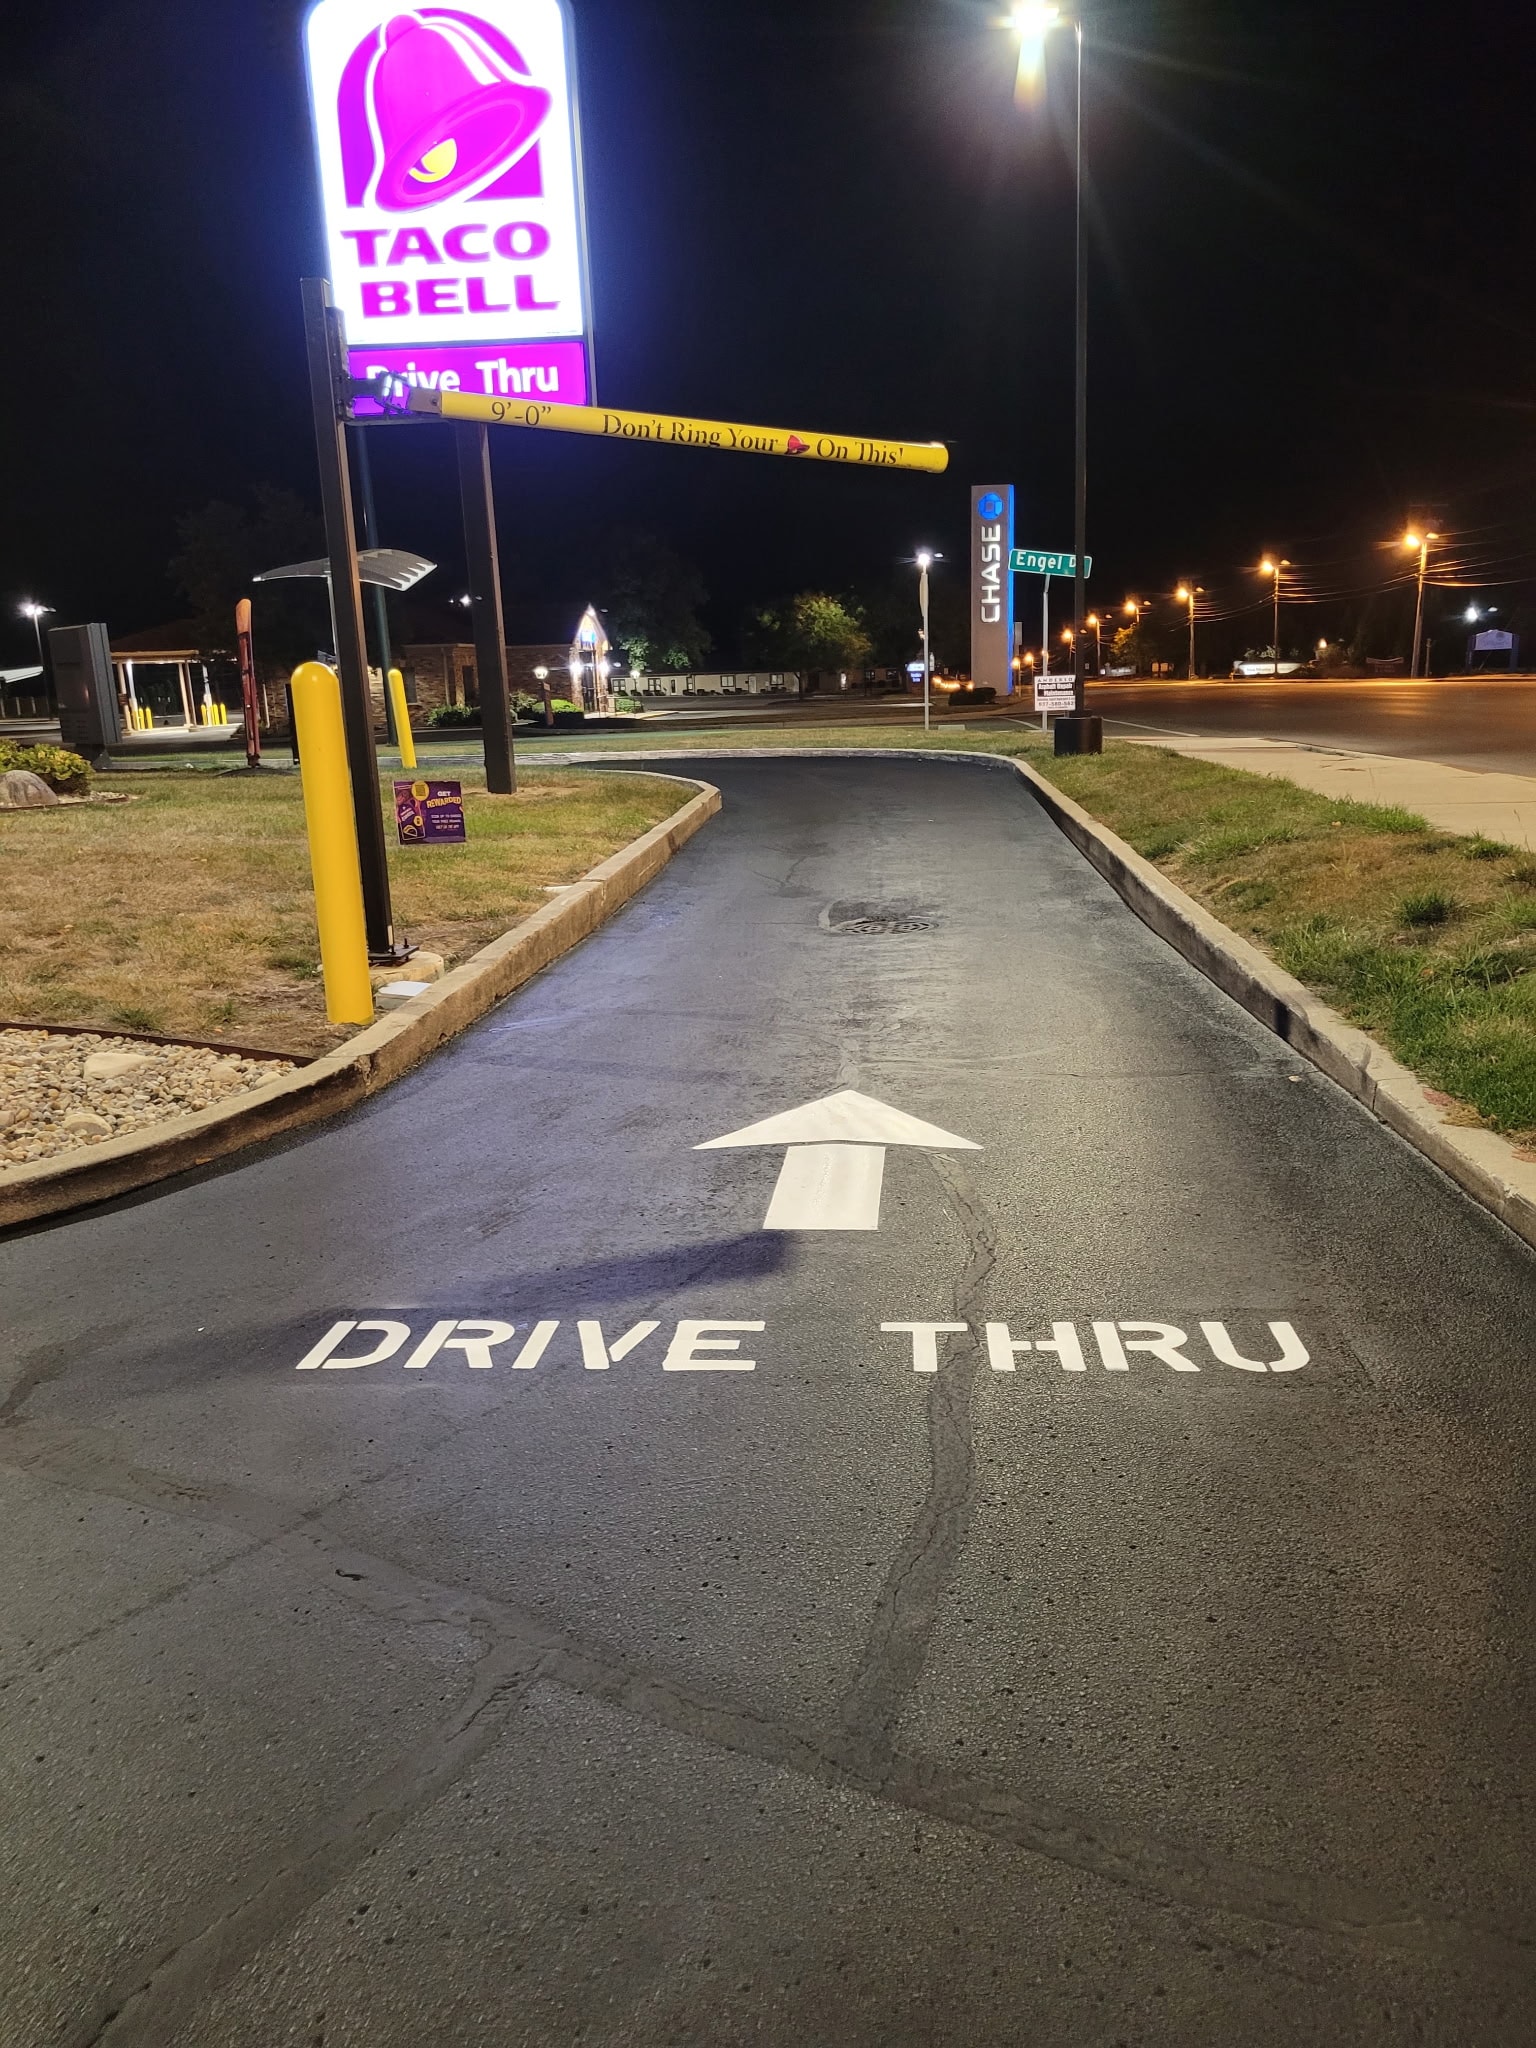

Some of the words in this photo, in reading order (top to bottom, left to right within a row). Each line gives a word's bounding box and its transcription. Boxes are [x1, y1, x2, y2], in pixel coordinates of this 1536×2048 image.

[340, 221, 551, 268] TACO
[360, 274, 561, 318] BELL
[475, 357, 559, 394] Thru
[602, 414, 665, 440] Don't
[671, 421, 722, 447] Ring
[727, 428, 779, 452] Your
[816, 438, 849, 459] On
[981, 524, 1001, 623] CHASE
[1016, 551, 1063, 572] Engel
[426, 796, 461, 809] REWARDED
[297, 1319, 765, 1372] DRIVE
[881, 1321, 1310, 1373] THRU
